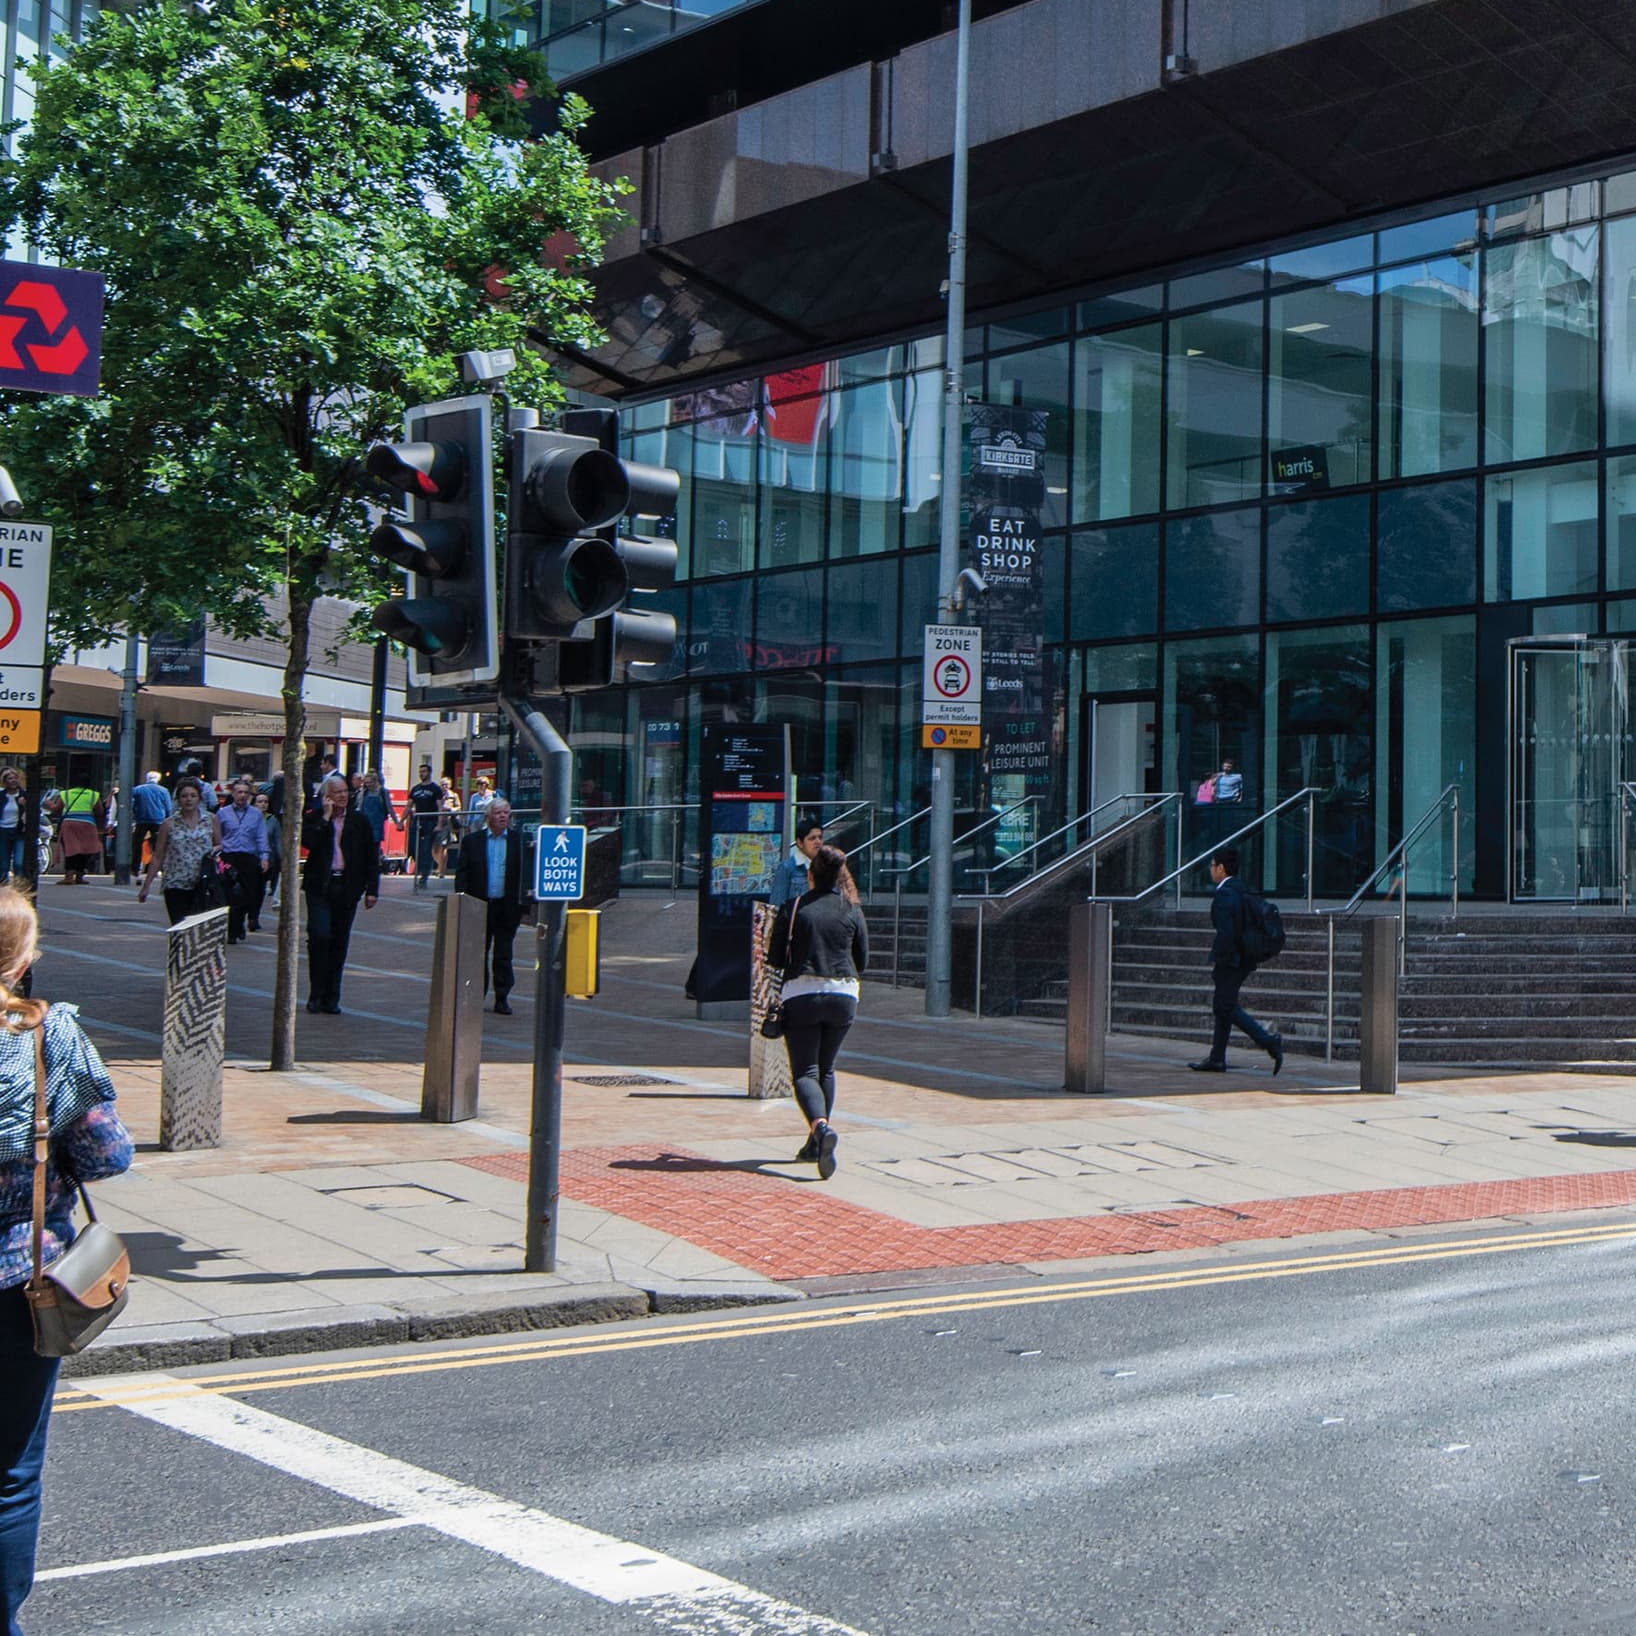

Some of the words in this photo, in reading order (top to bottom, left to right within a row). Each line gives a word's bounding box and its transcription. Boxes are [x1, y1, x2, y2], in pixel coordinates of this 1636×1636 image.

[1278, 457, 1314, 477] harris
[990, 518, 1025, 534] EAT
[976, 535, 1036, 553] DRINK
[981, 553, 1032, 569] SHOP
[983, 570, 1031, 584] Experience
[928, 627, 978, 637] PEDESTRIAN
[935, 639, 971, 650] ZONE
[998, 679, 1023, 689] Leeds
[940, 704, 965, 714] Except
[926, 713, 949, 721] permit
[76, 723, 112, 742] GREGGS
[1005, 724, 1018, 734] TO
[1021, 722, 1035, 733] LET
[994, 742, 1046, 755] PROMINENT
[991, 757, 1026, 769] LEISURE
[1028, 756, 1049, 768] UNIT
[544, 856, 577, 867] LOOK
[544, 869, 577, 879] BOTH
[543, 882, 577, 892] WAYS
